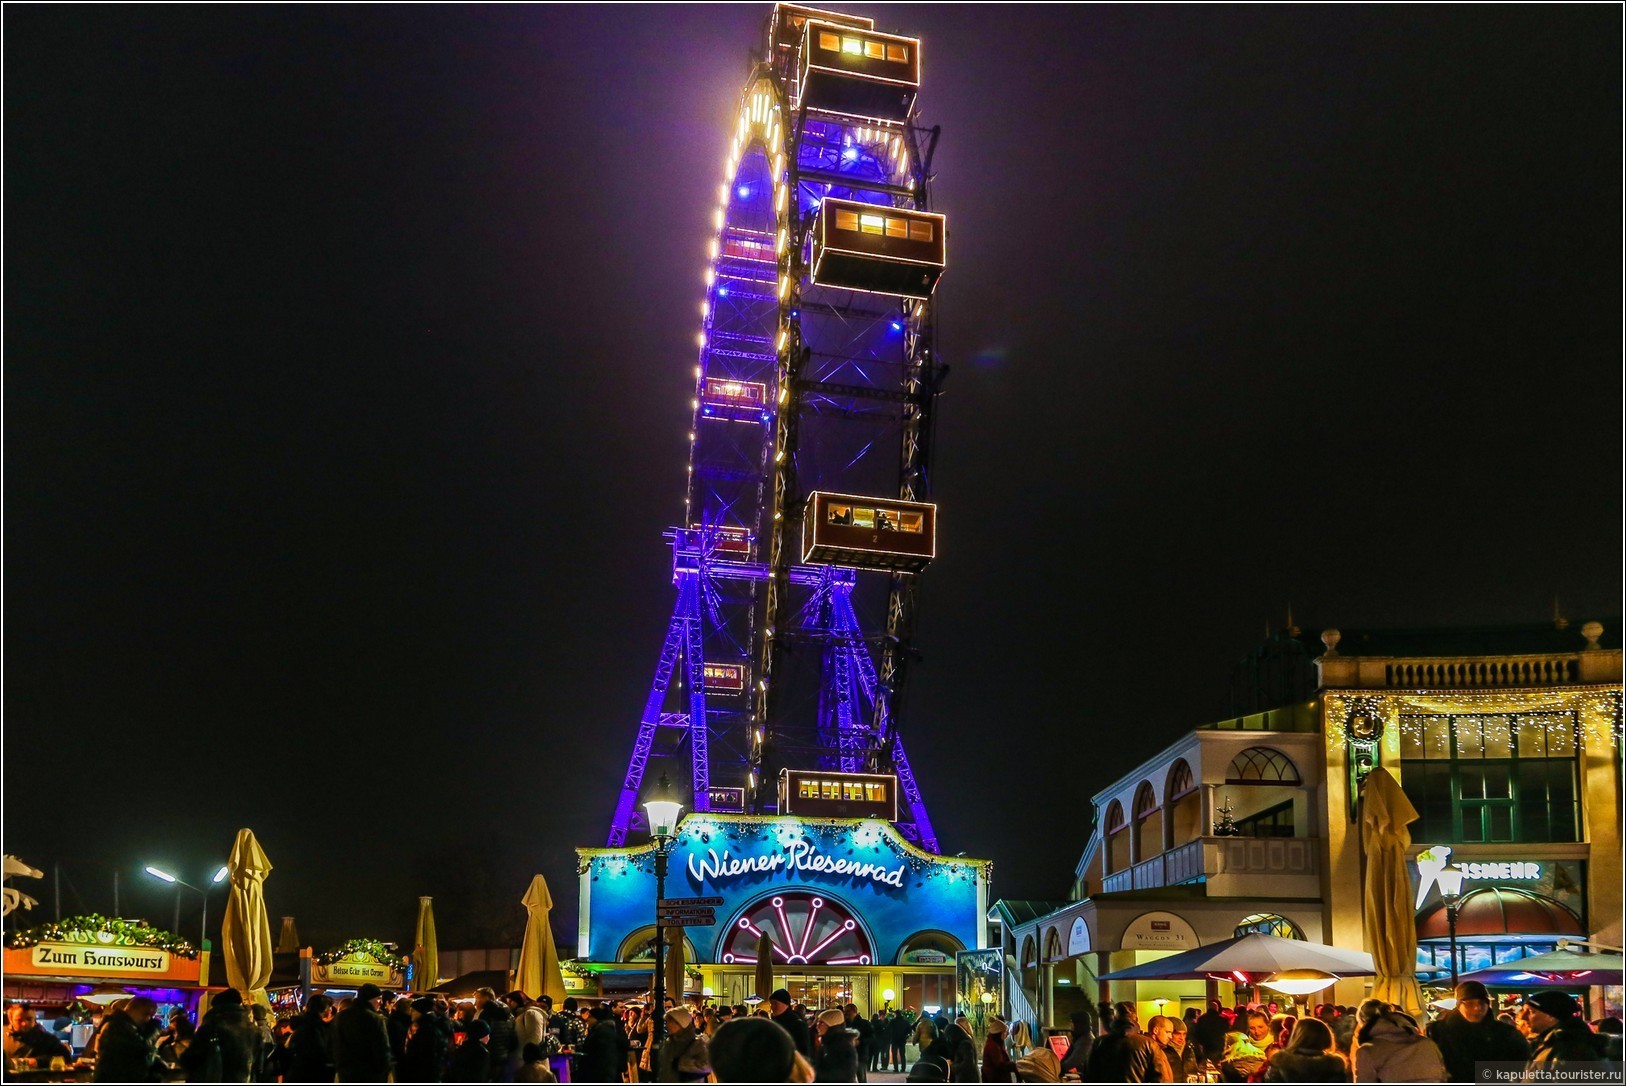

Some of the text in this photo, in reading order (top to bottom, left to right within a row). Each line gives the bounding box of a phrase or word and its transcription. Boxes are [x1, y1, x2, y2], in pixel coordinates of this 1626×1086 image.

[688, 841, 906, 888] Wiener Riesenrad
[666, 907, 707, 915] INFORMATION
[38, 947, 163, 969] Zum Hanswurst
[362, 968, 370, 976] Hot
